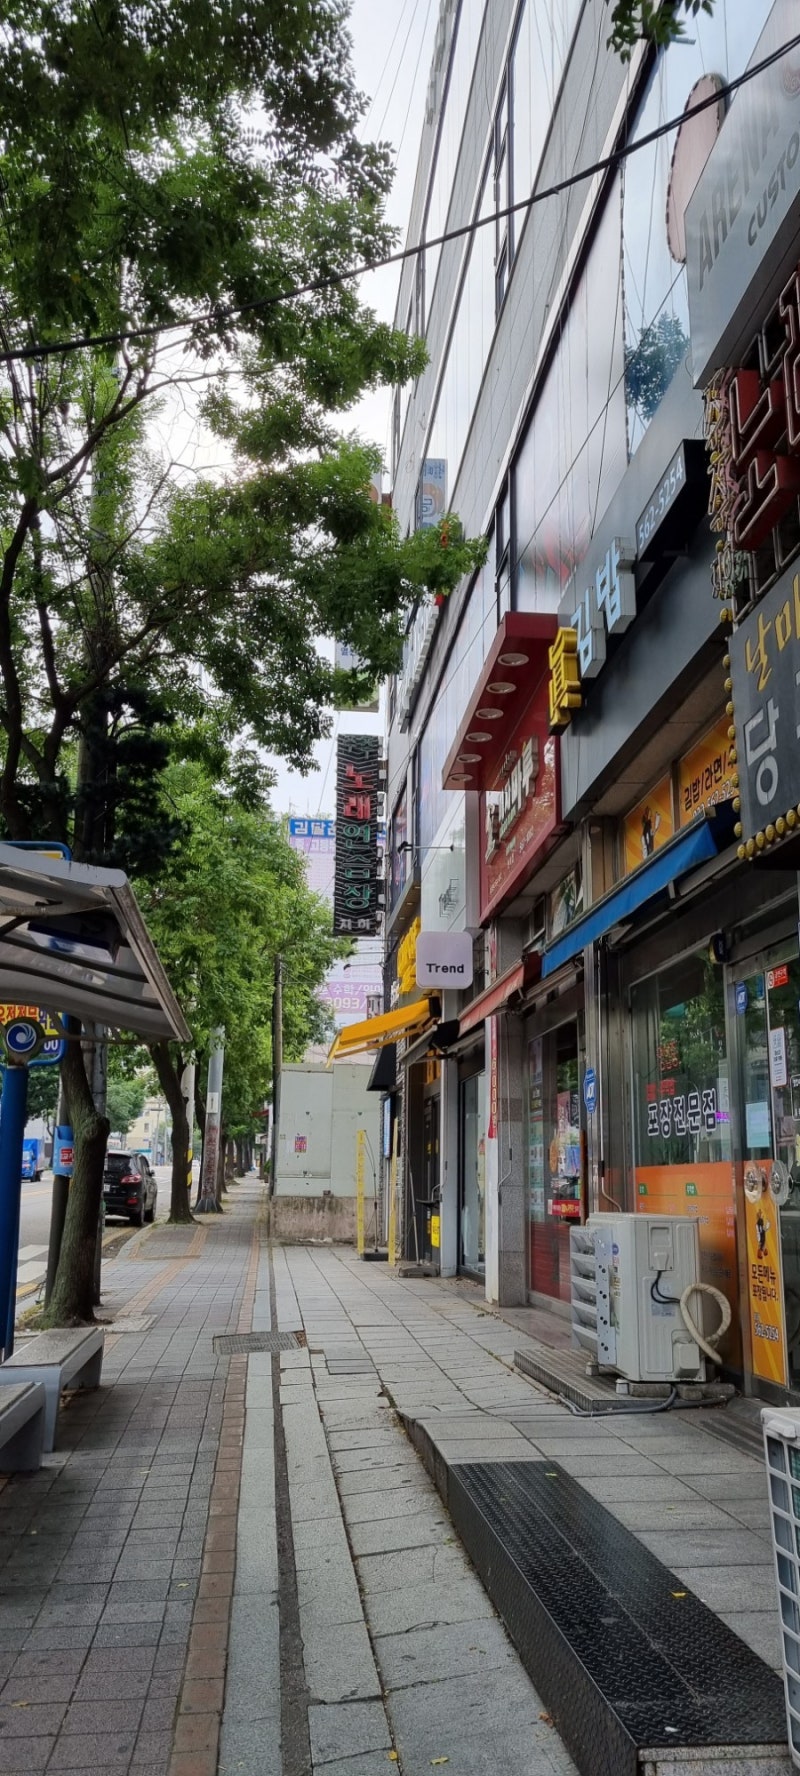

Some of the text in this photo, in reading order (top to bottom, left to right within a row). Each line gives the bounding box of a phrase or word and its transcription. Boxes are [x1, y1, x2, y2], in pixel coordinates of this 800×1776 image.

[699, 100, 780, 292] ARENA
[747, 117, 800, 247] CUSTO
[638, 455, 683, 549] 562-5254
[342, 763, 374, 909] 노래연습장
[340, 919, 371, 930] 지하
[426, 963, 464, 974] Trend
[647, 1088, 717, 1138] 포장전문점
[752, 1263, 776, 1285] 모든메뉴
